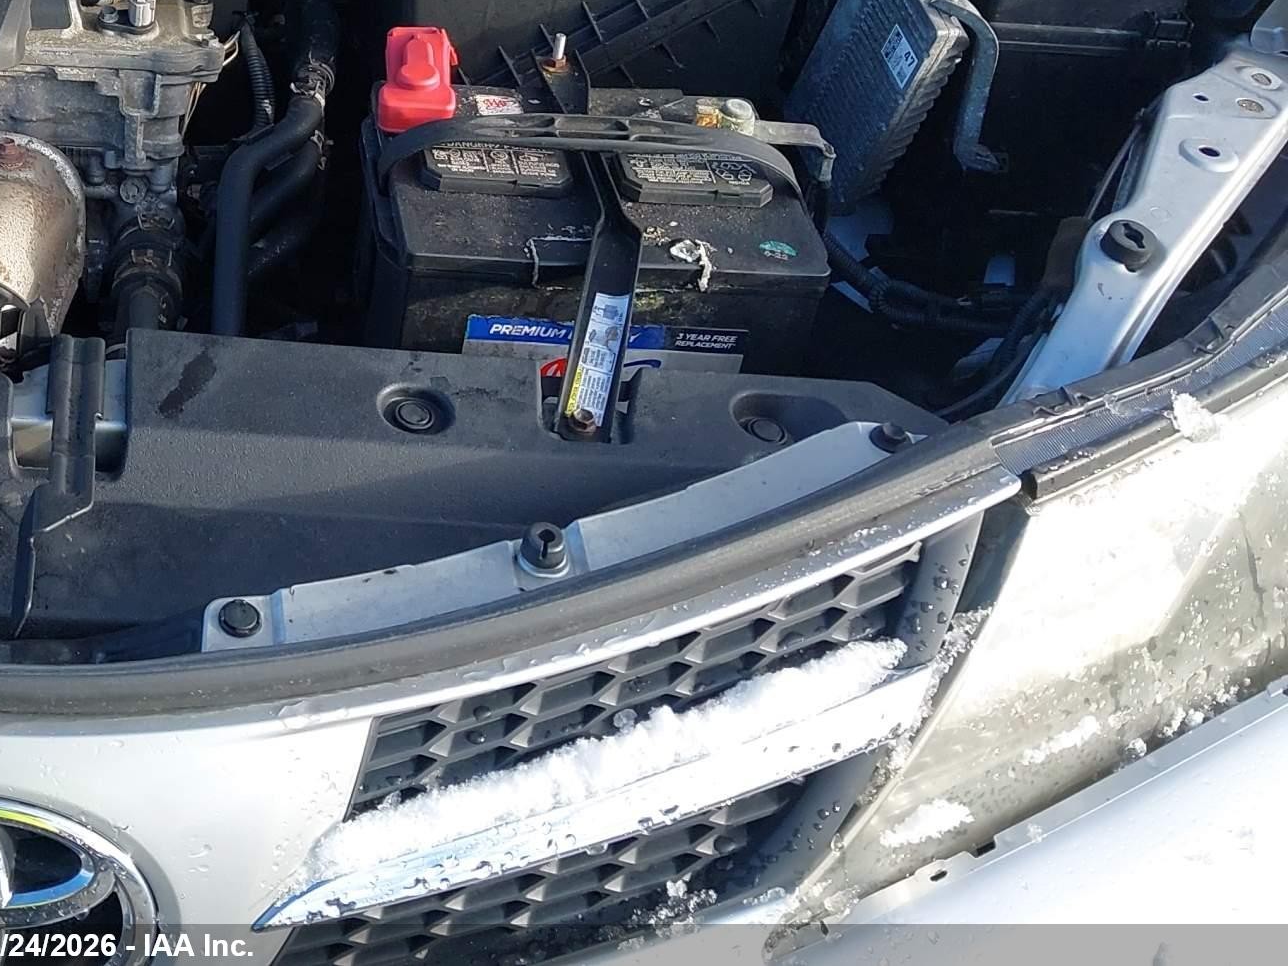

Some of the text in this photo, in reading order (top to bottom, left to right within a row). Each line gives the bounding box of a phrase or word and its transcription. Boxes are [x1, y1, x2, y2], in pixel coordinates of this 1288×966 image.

[489, 324, 566, 339] PREMIUM
[686, 333, 711, 341] YEAR
[711, 335, 738, 343] FREE
